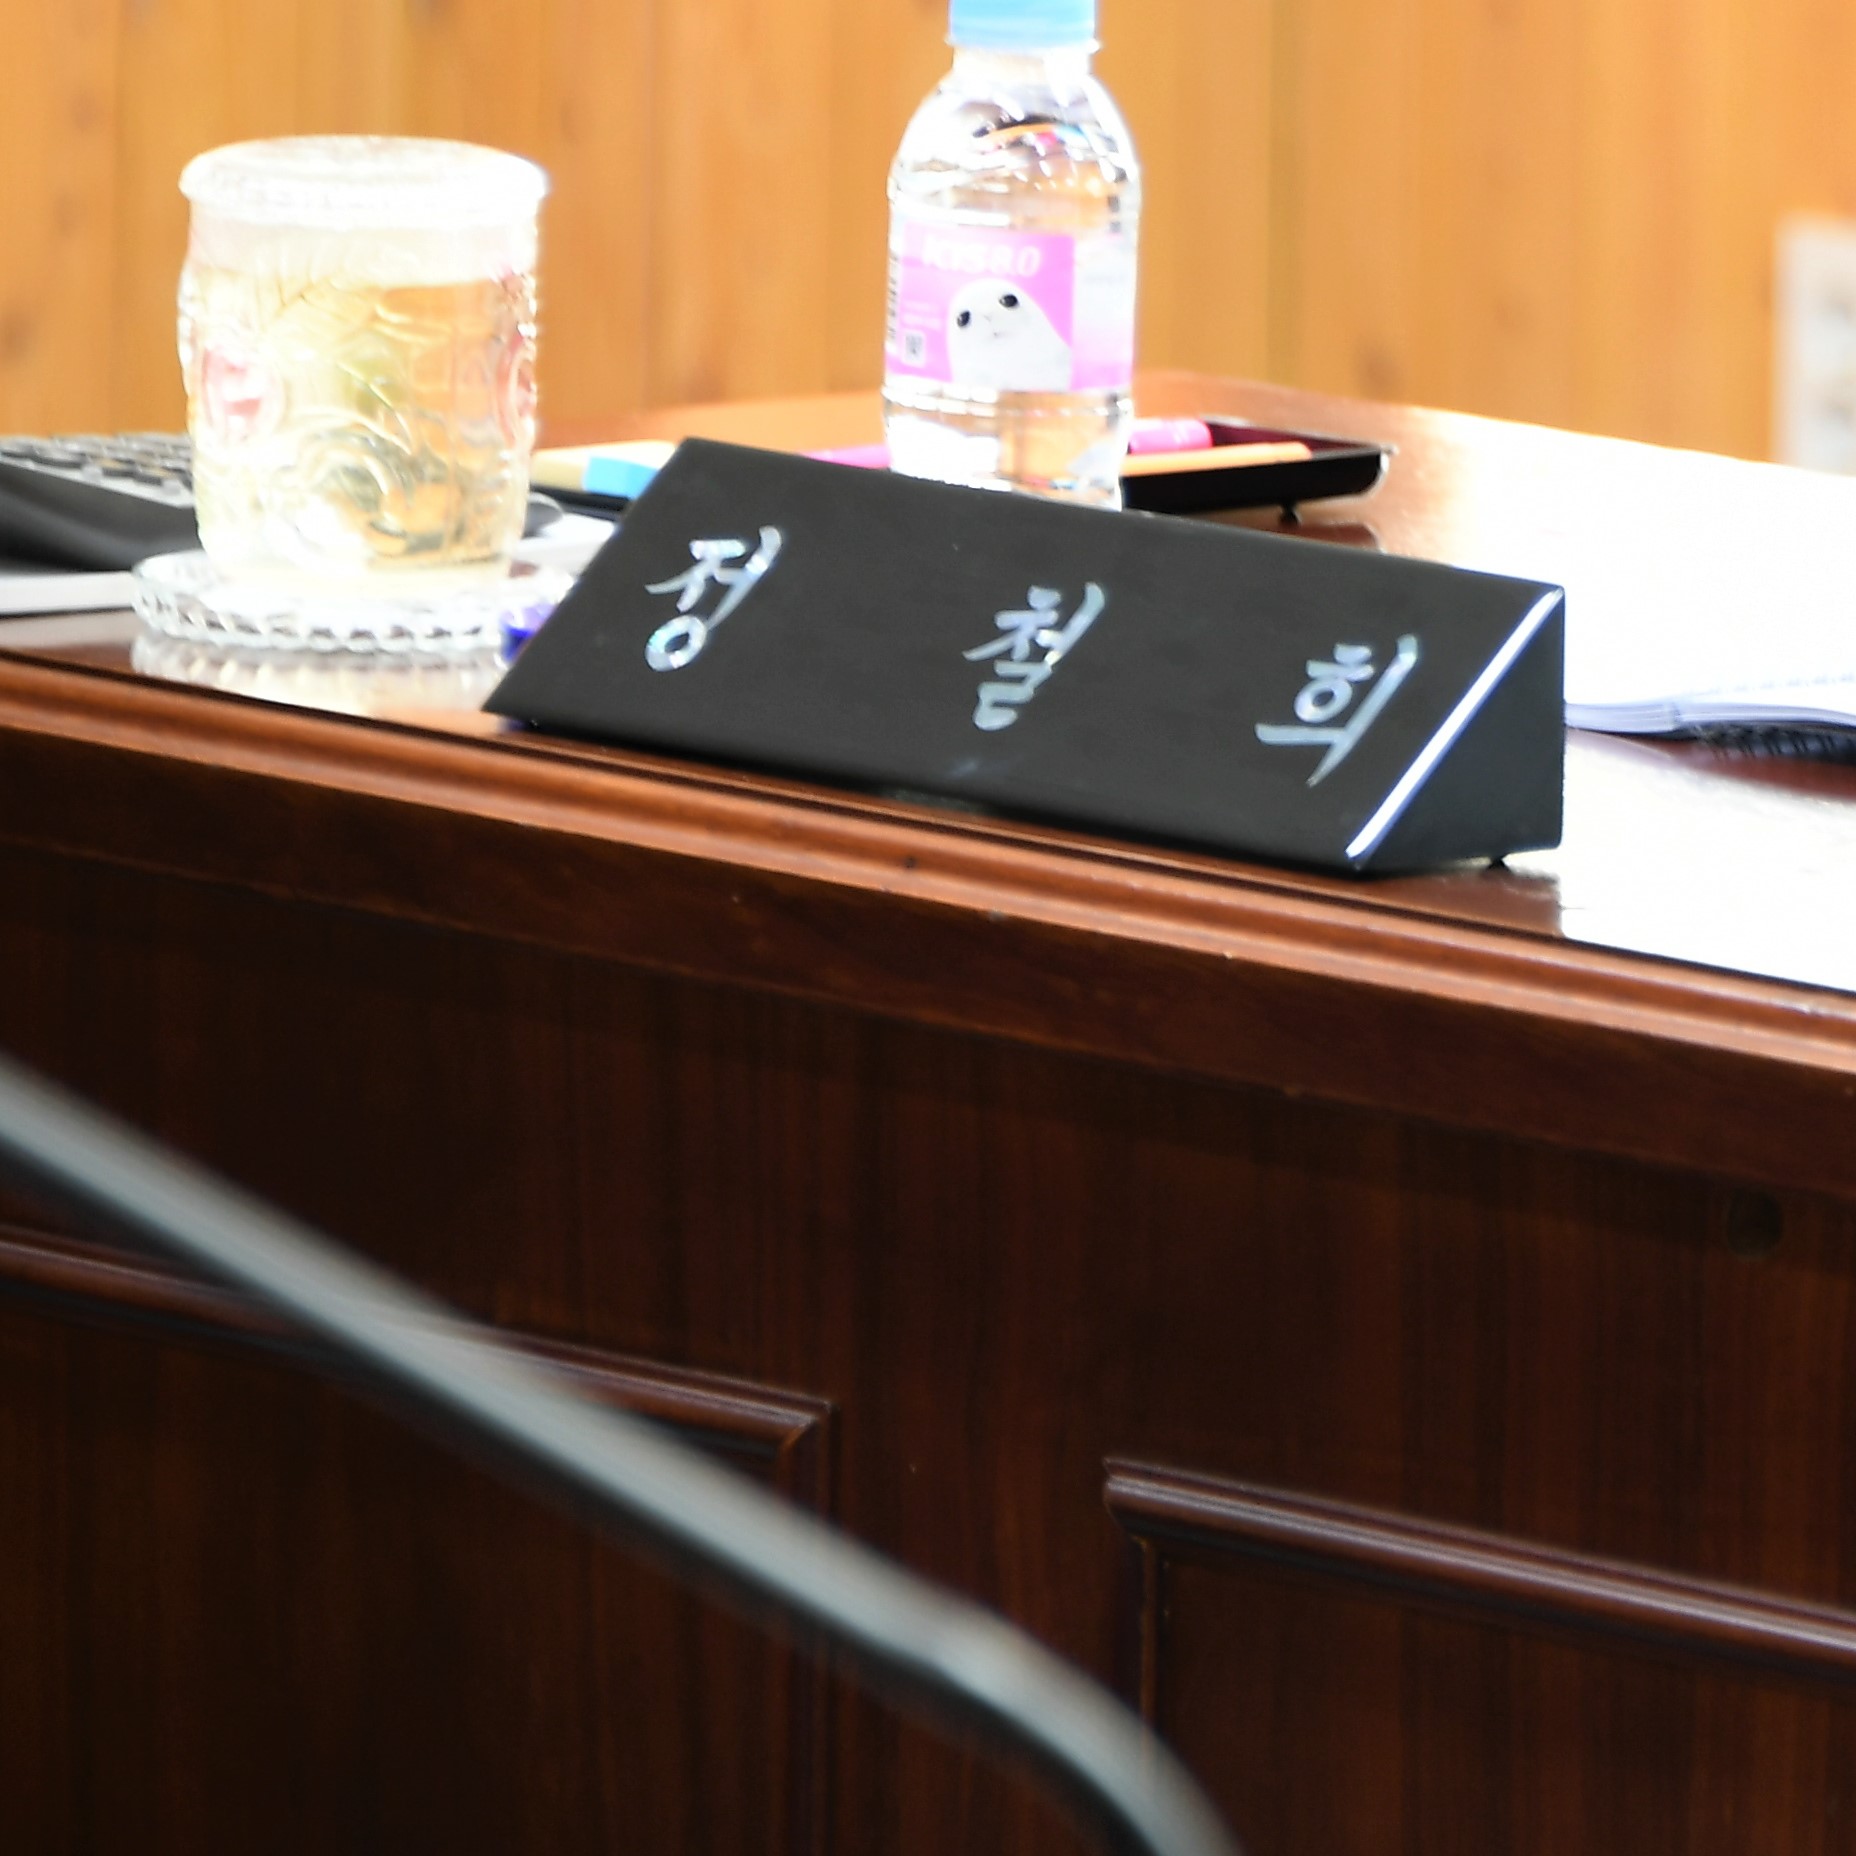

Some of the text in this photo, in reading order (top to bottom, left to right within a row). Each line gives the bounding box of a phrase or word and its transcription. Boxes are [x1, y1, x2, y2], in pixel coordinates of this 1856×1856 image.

[645, 525, 1419, 789] 정 철 희
